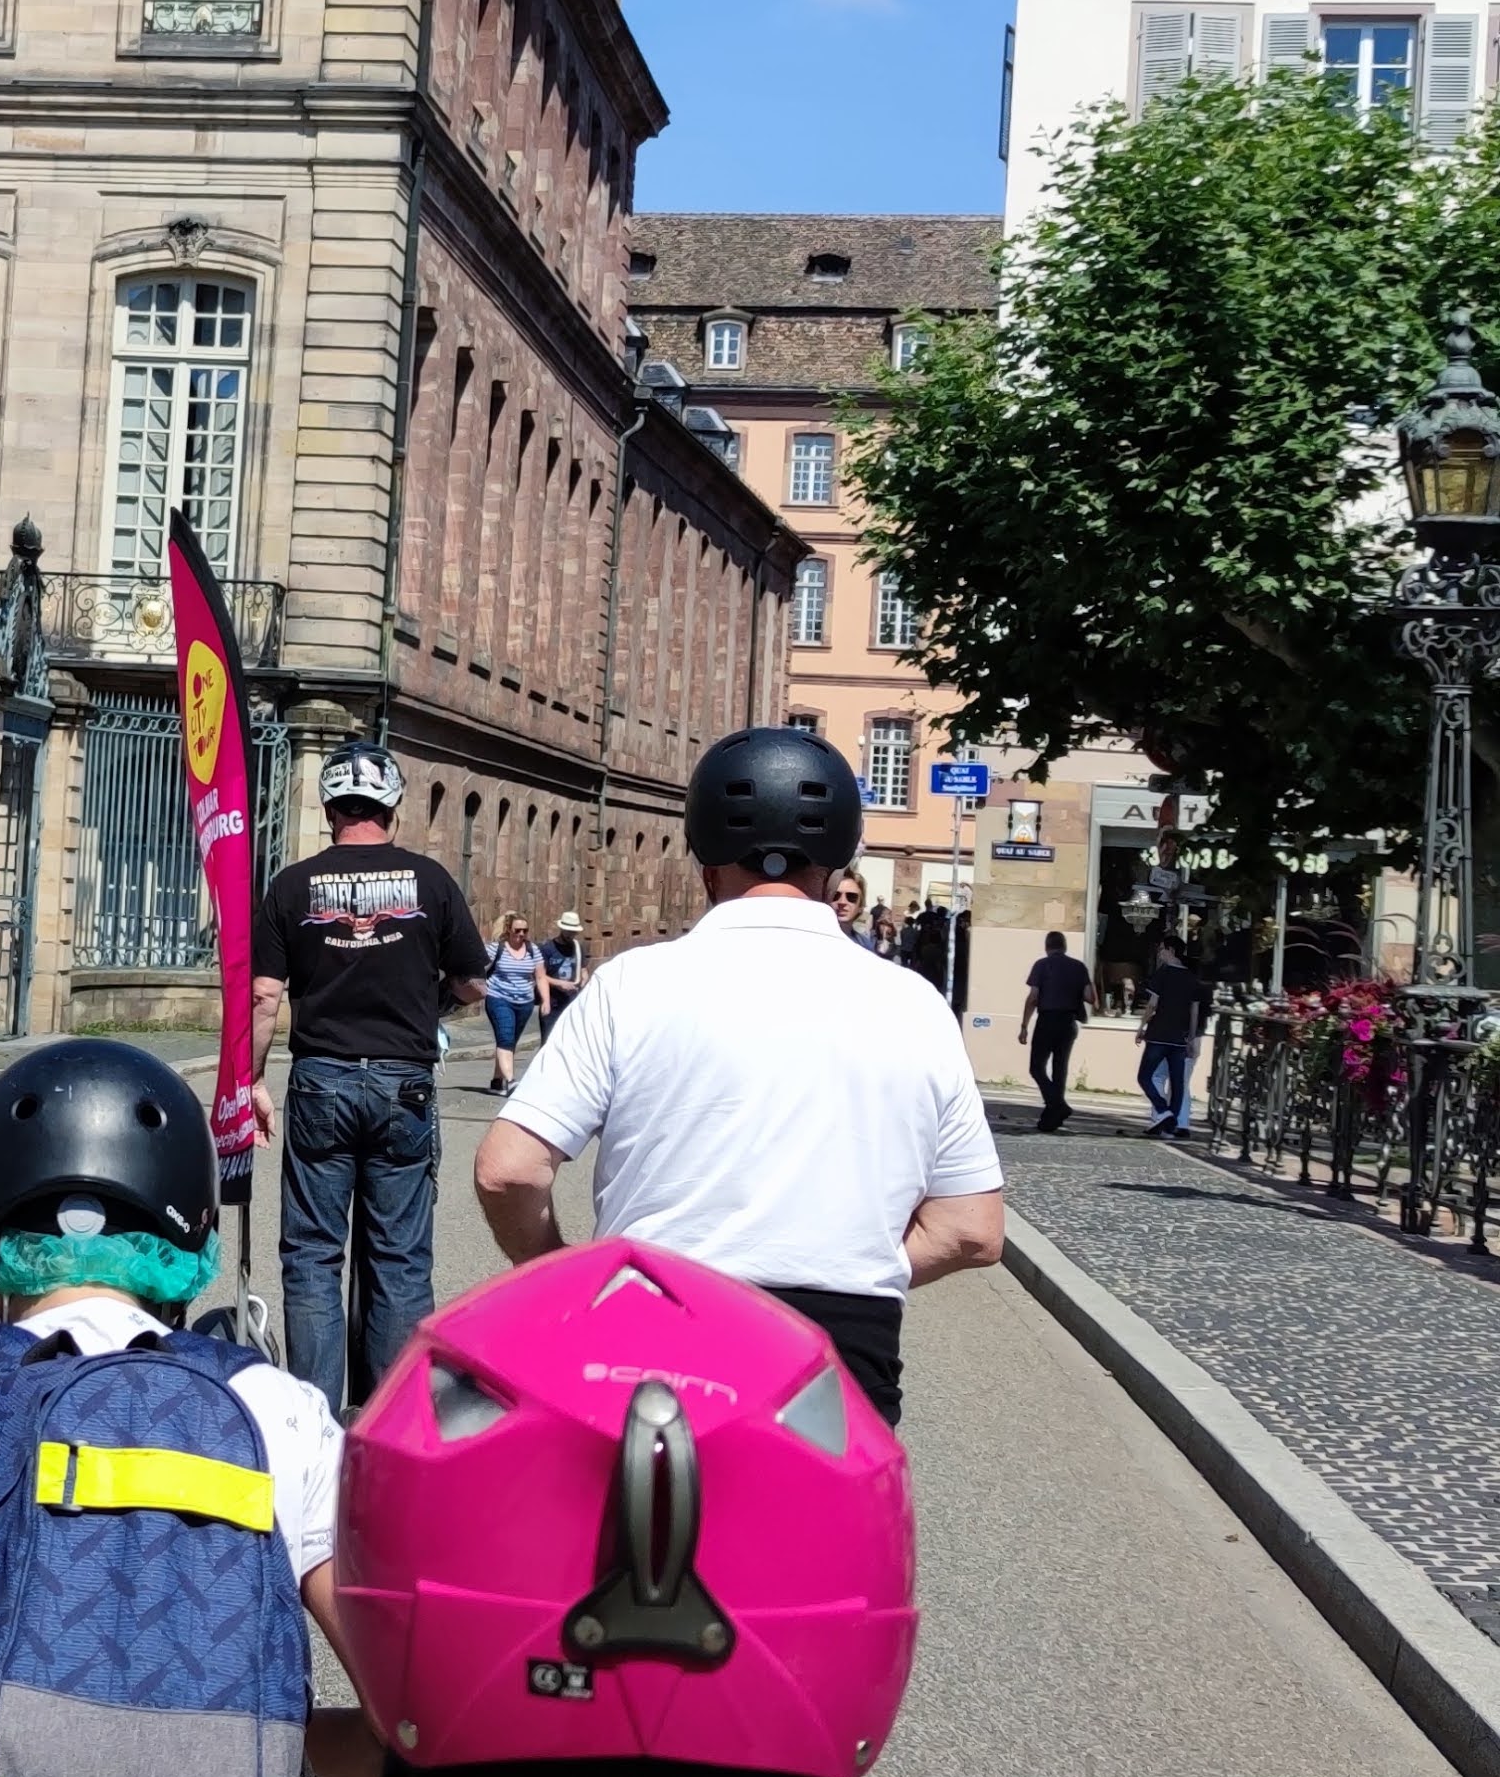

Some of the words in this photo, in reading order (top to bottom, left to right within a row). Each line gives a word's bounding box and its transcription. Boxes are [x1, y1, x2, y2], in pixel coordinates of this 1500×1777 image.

[193, 668, 214, 700] ONE
[196, 787, 219, 827] OLMAR
[996, 847, 1013, 855] QUAI
[310, 869, 415, 886] HOLLYWOOD
[308, 878, 418, 917] HARLEY-DAVIDSON
[382, 931, 404, 944] USA
